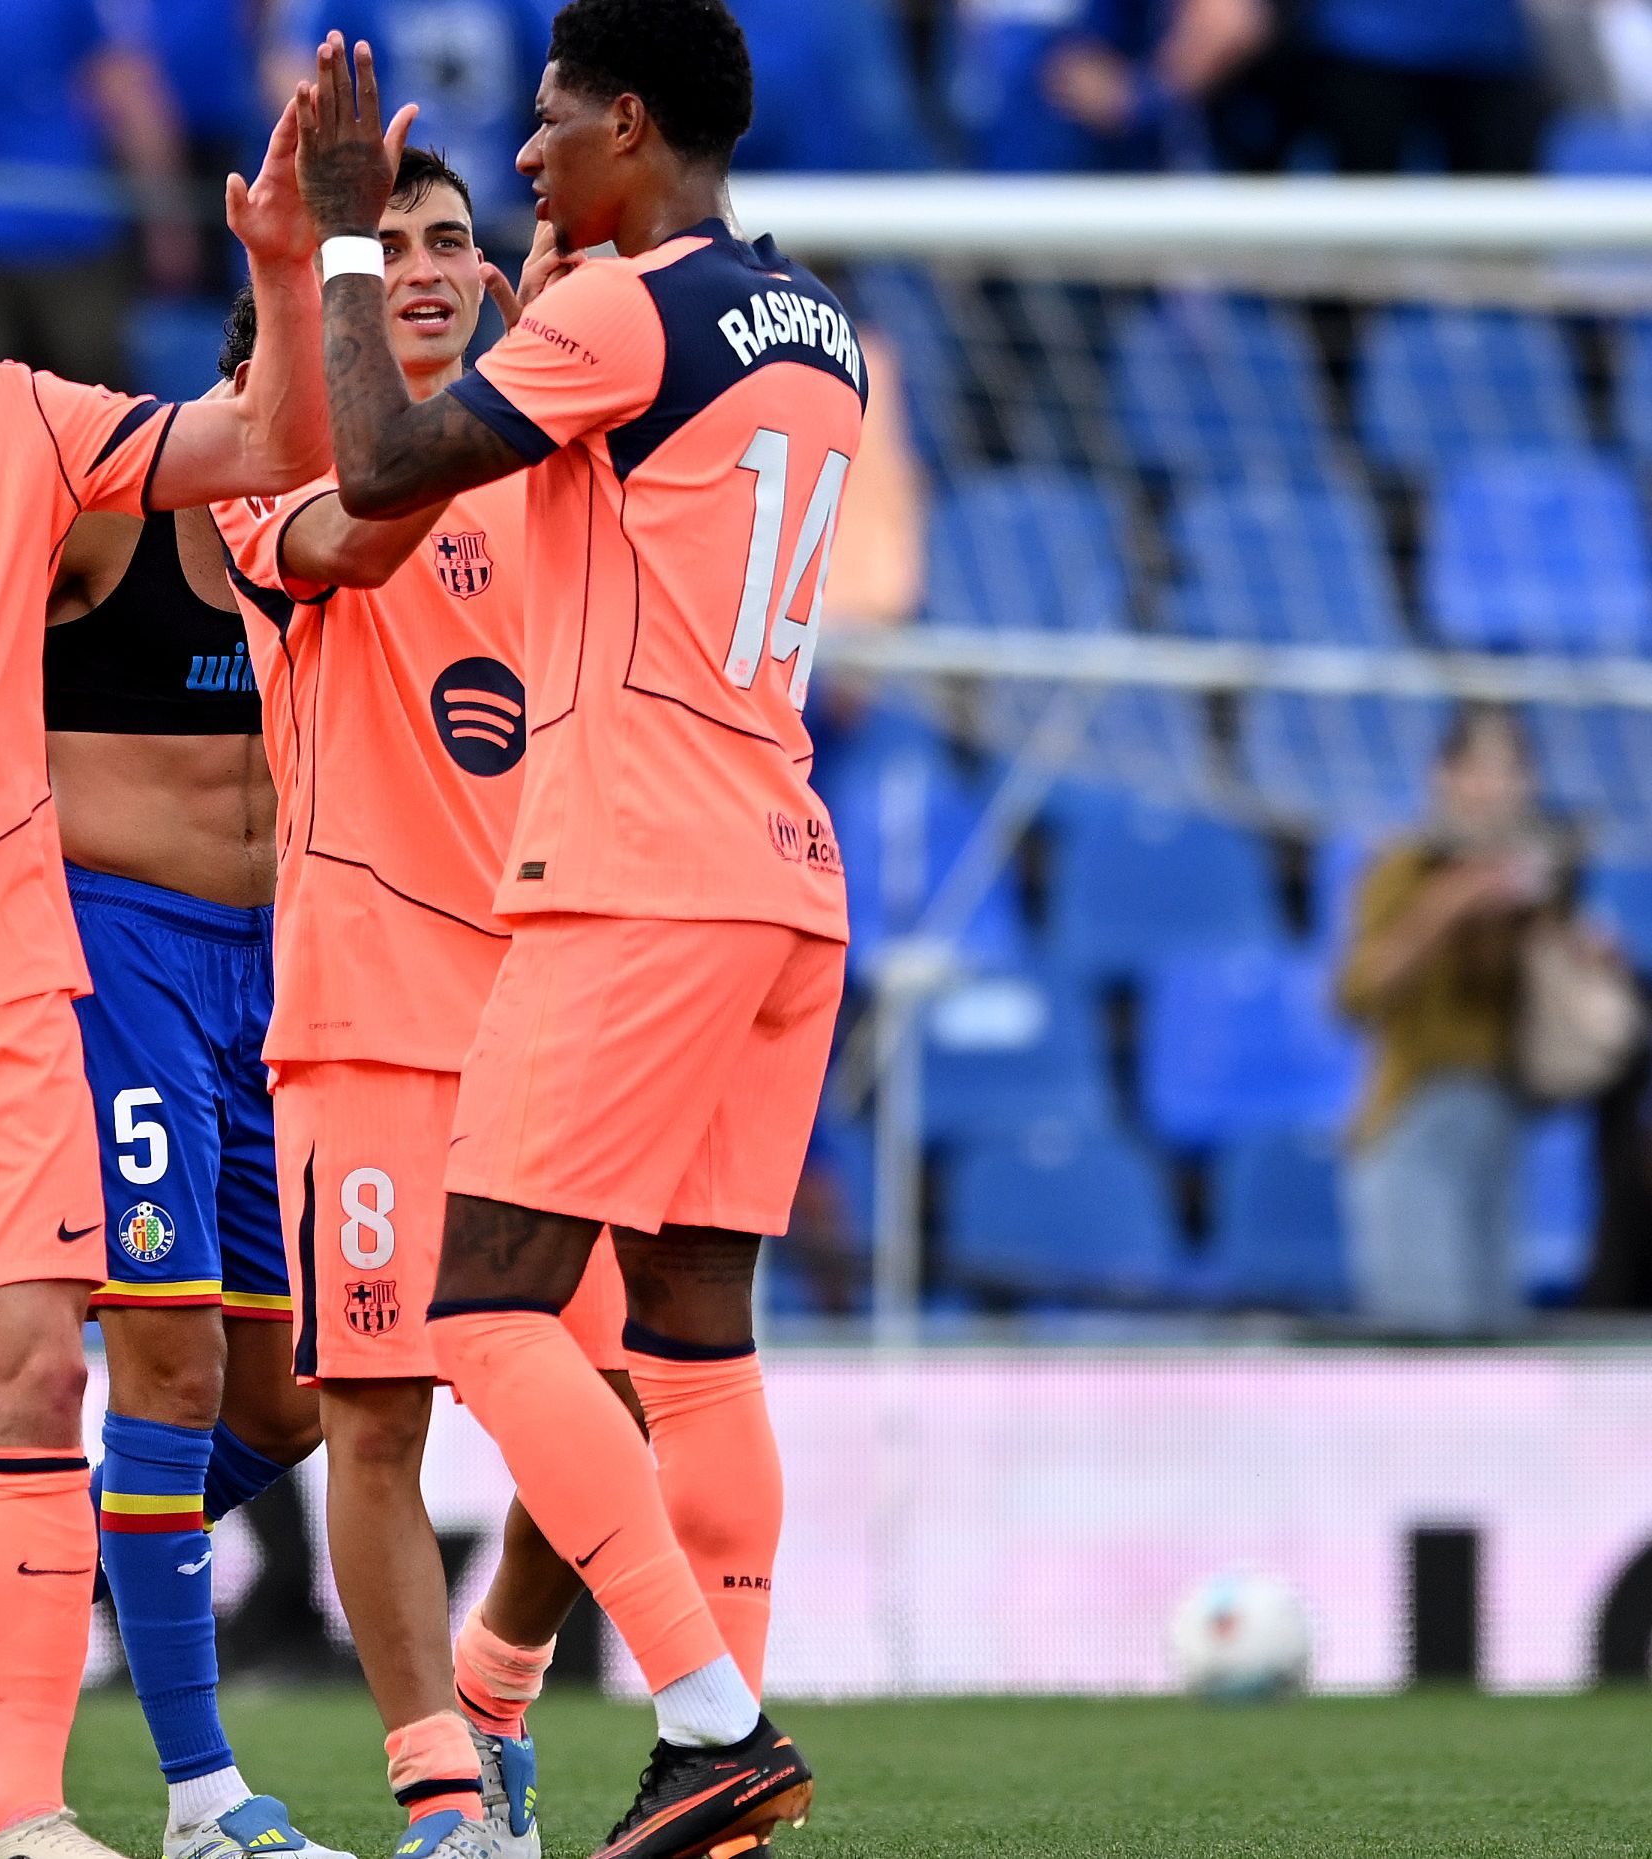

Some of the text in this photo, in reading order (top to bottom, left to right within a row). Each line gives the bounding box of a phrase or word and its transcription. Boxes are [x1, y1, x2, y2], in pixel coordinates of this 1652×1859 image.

[582, 350, 601, 366] tv
[449, 560, 471, 569] FCB
[722, 427, 851, 711] 14
[113, 1086, 169, 1185] 5
[340, 1167, 395, 1270] 8
[723, 1575, 772, 1591] BARC
